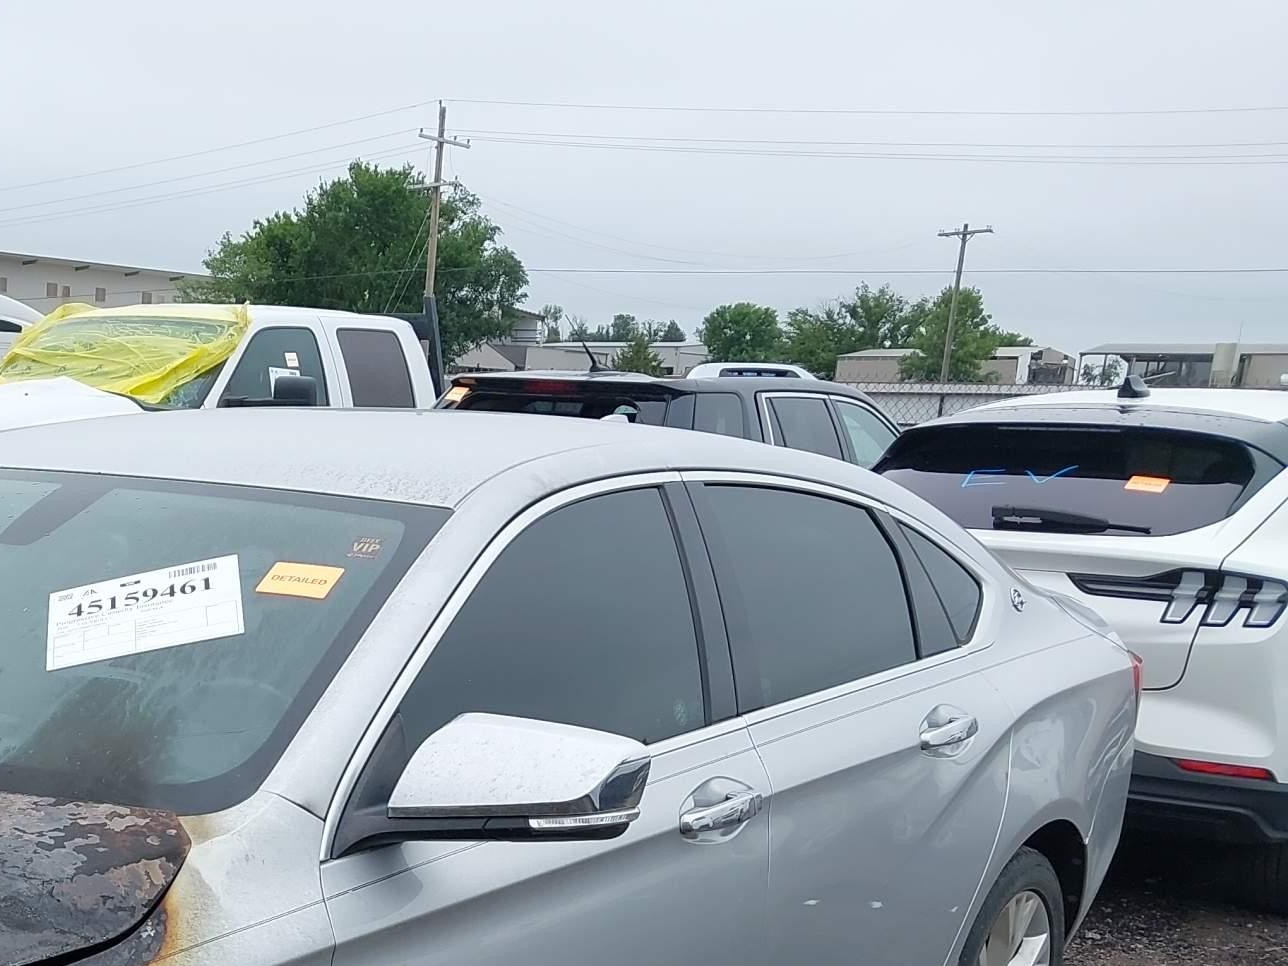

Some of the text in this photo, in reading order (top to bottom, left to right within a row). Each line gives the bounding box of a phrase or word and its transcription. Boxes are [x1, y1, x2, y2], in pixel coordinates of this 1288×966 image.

[353, 542, 380, 553] VIP
[271, 574, 328, 586] DETAILED
[68, 577, 216, 617] 45159461
